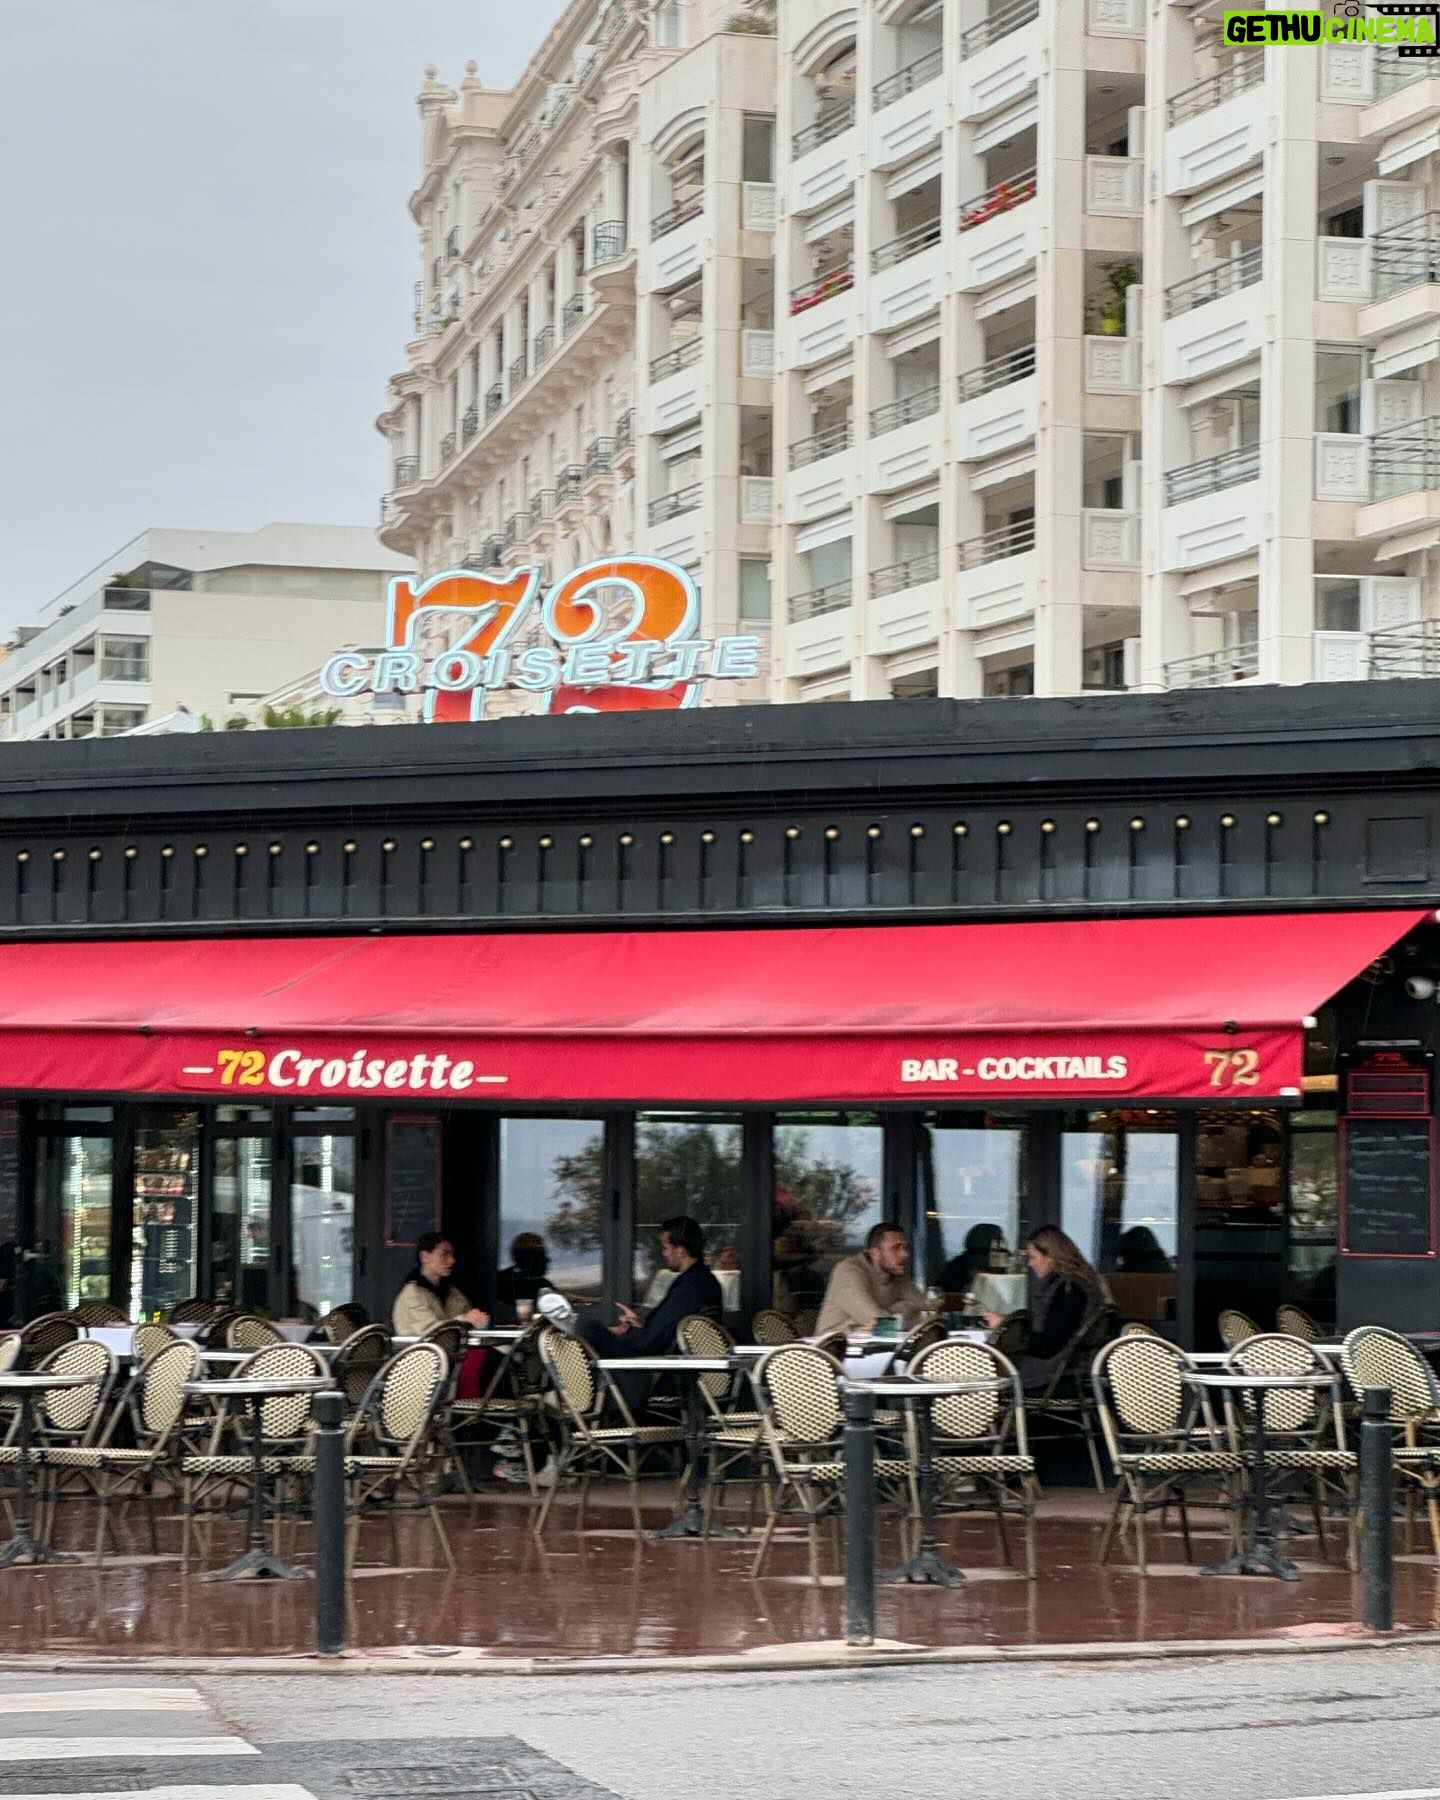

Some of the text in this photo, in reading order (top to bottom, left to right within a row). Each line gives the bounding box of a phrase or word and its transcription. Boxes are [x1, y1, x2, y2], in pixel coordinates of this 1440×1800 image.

[386, 555, 704, 724] 72
[320, 635, 762, 697] CROISETTE
[267, 1048, 475, 1090] Croisette
[1203, 1049, 1261, 1087] 72
